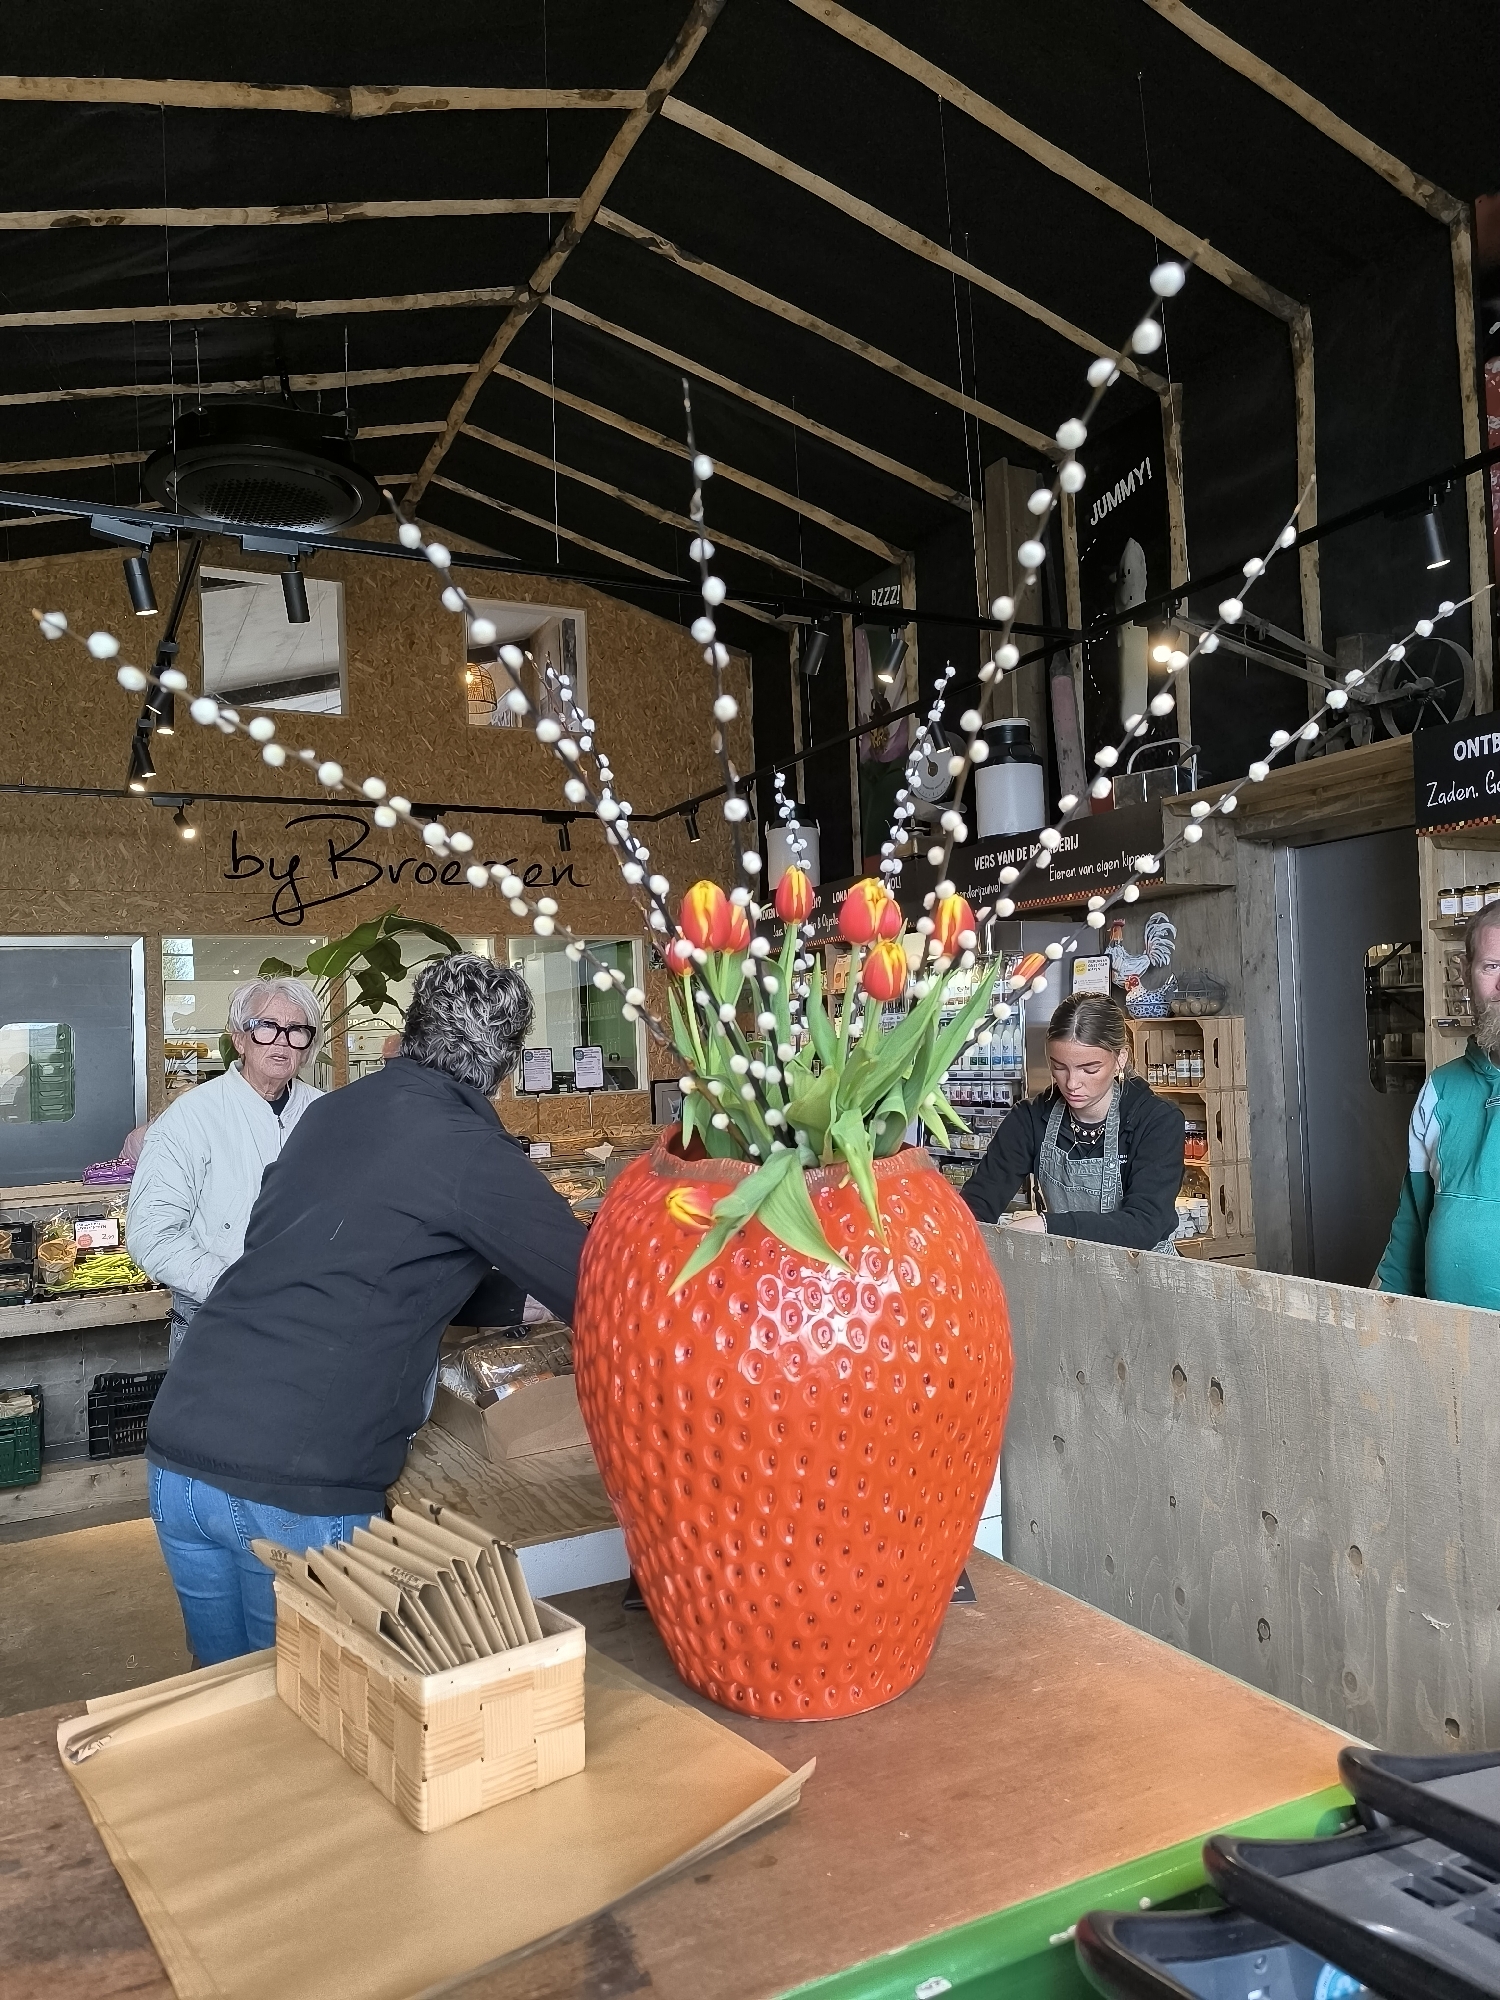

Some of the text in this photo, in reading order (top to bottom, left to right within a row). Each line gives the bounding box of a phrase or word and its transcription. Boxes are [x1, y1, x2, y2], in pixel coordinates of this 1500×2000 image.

[1090, 456, 1152, 526] JUMMY!
[871, 584, 901, 607] BZZZ!
[1453, 732, 1500, 761] ONTB
[224, 813, 591, 927] by Broeen
[974, 853, 996, 871] VERS
[997, 848, 1015, 867] VAN
[1016, 846, 1028, 862] DE
[1049, 863, 1077, 881] Eieren
[1078, 864, 1094, 876] van
[1096, 858, 1120, 877] eigen
